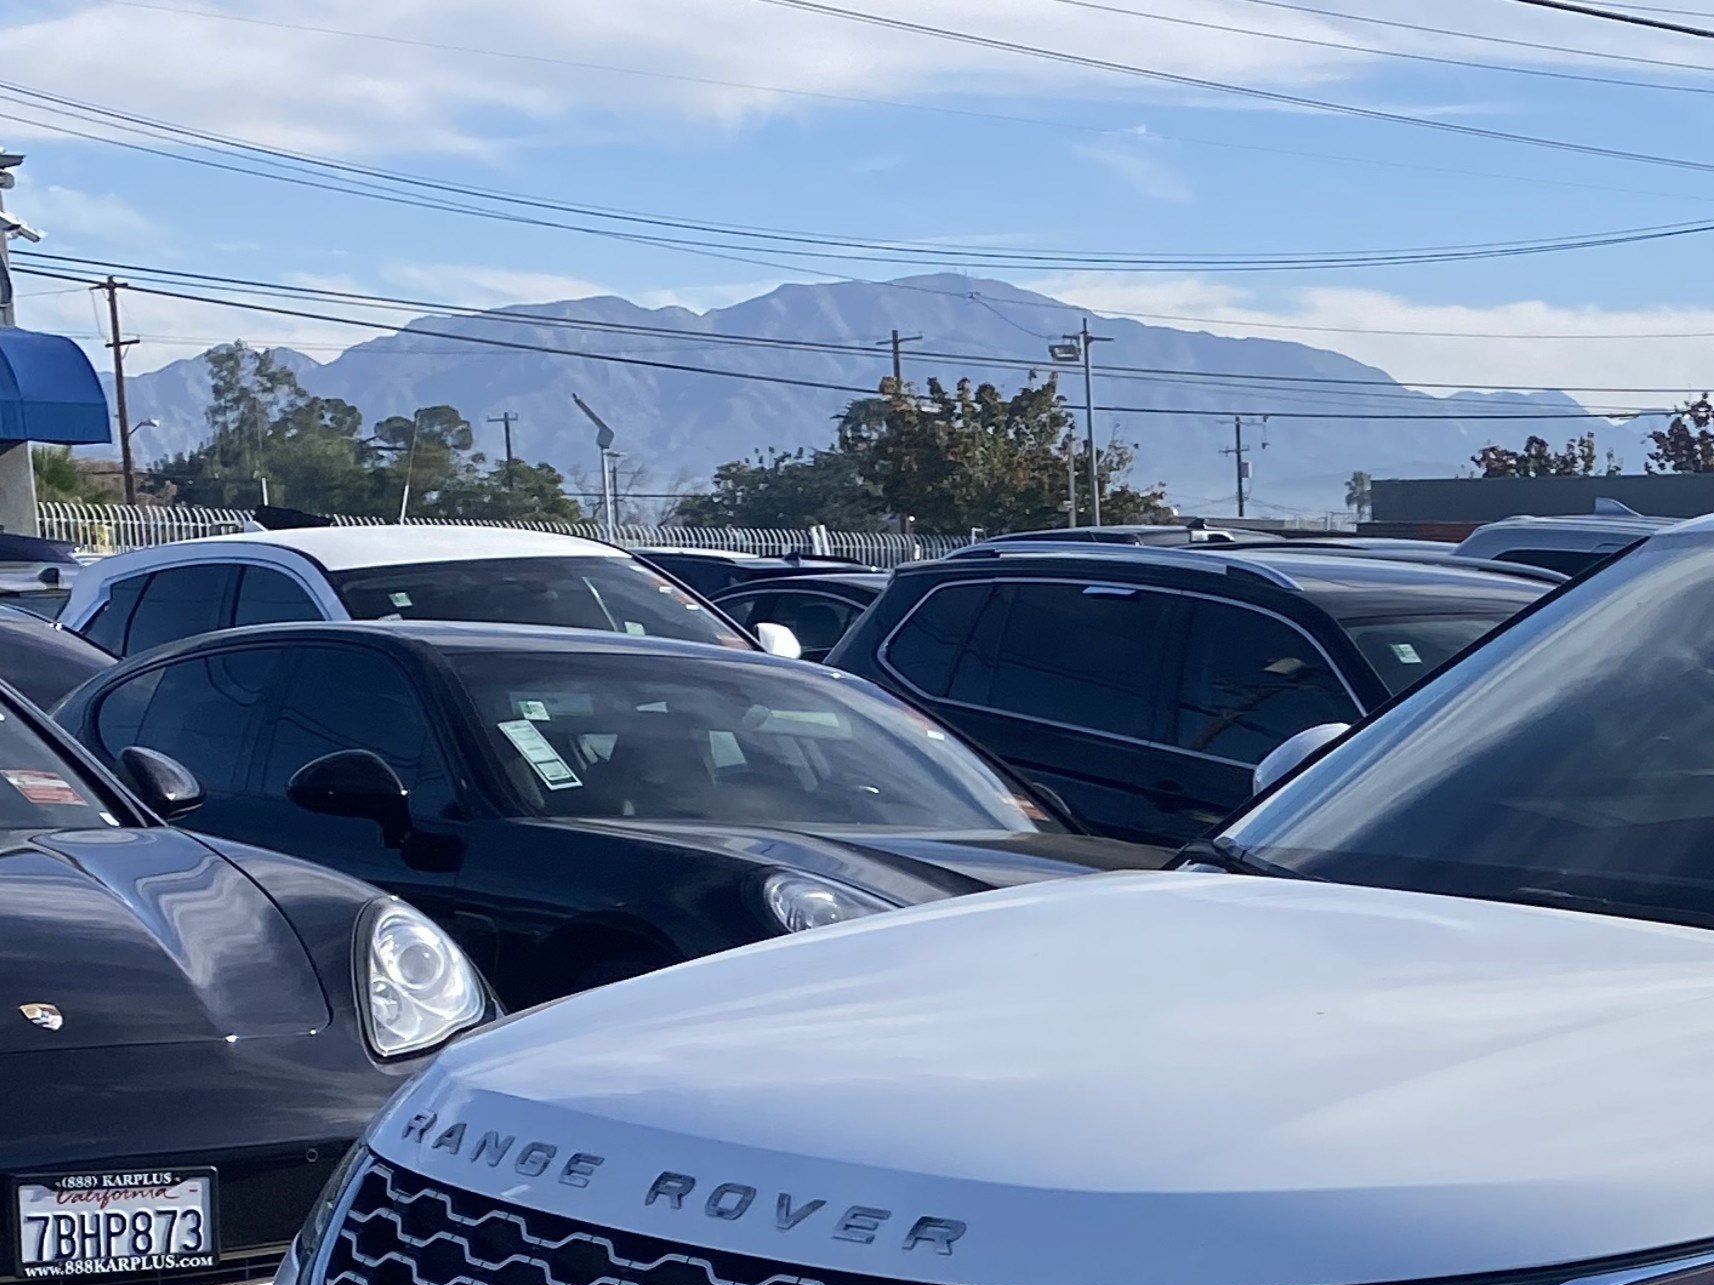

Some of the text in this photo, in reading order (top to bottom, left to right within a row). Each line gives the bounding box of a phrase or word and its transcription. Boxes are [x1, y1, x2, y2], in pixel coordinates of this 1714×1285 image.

[61, 1172, 172, 1189] (888) KARPLUS
[401, 1110, 968, 1255] RANGE ROVER
[24, 1208, 203, 1262] 7BHP873
